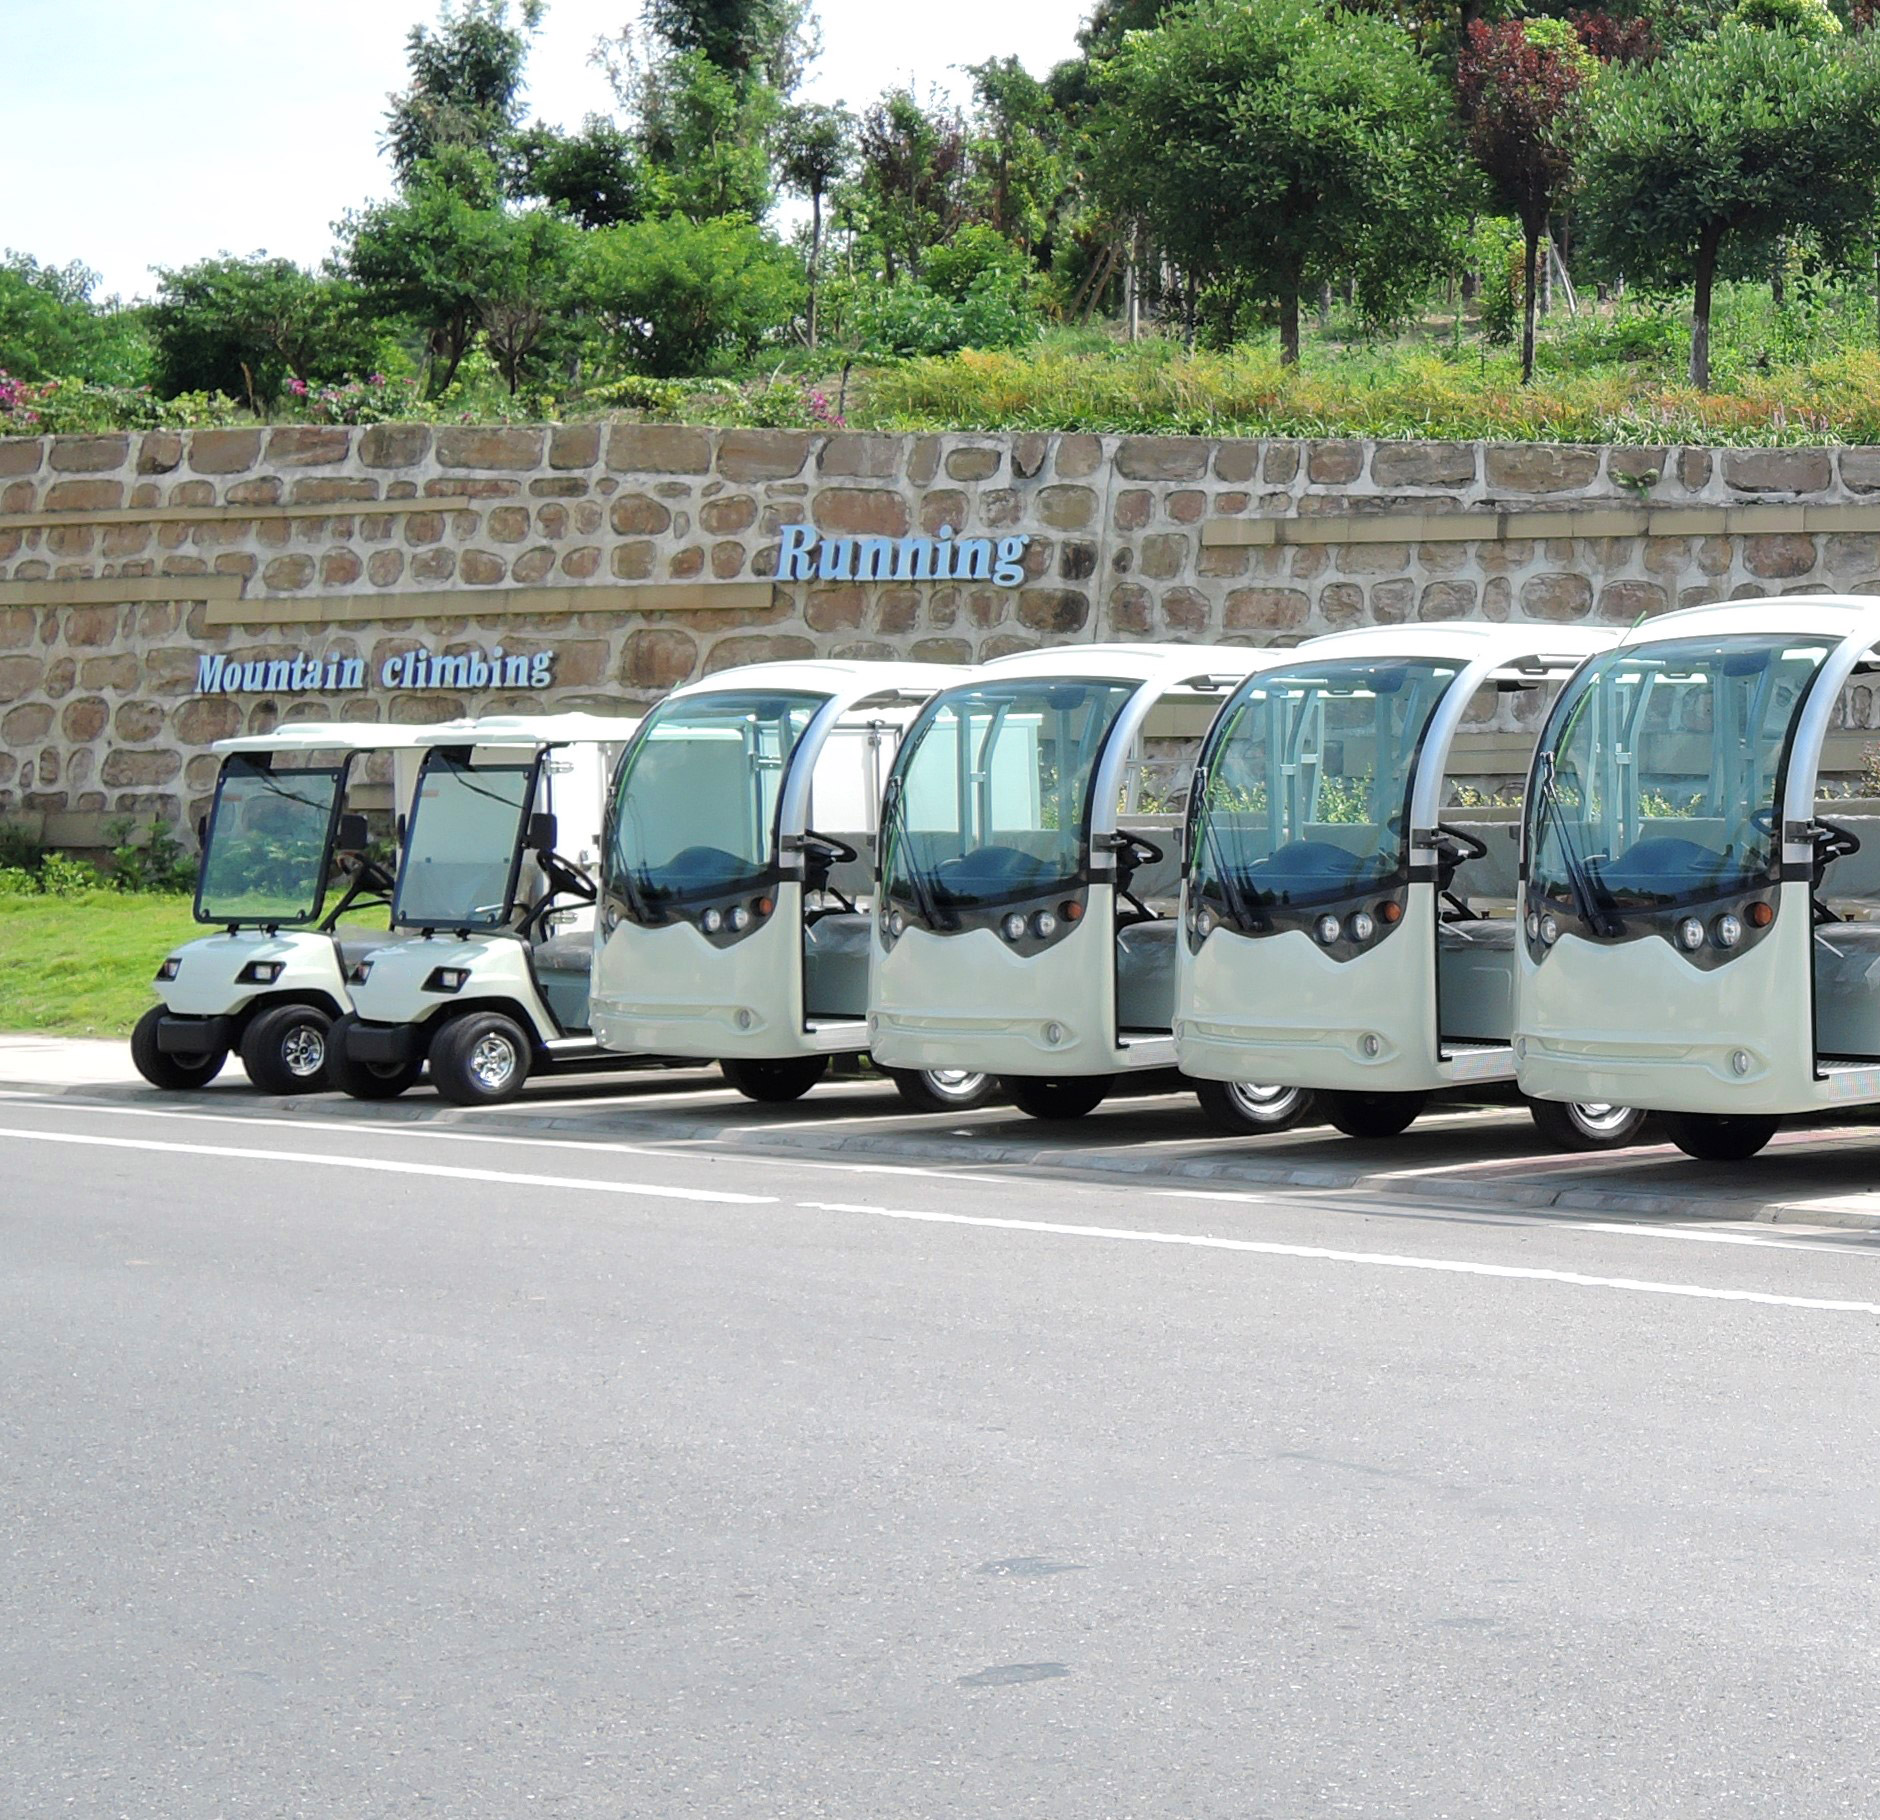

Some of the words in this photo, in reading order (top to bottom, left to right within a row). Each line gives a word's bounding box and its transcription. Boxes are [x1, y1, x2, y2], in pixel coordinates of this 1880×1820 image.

[775, 524, 1030, 587] Running
[195, 652, 365, 693] Mountain
[381, 647, 554, 689] climbing
